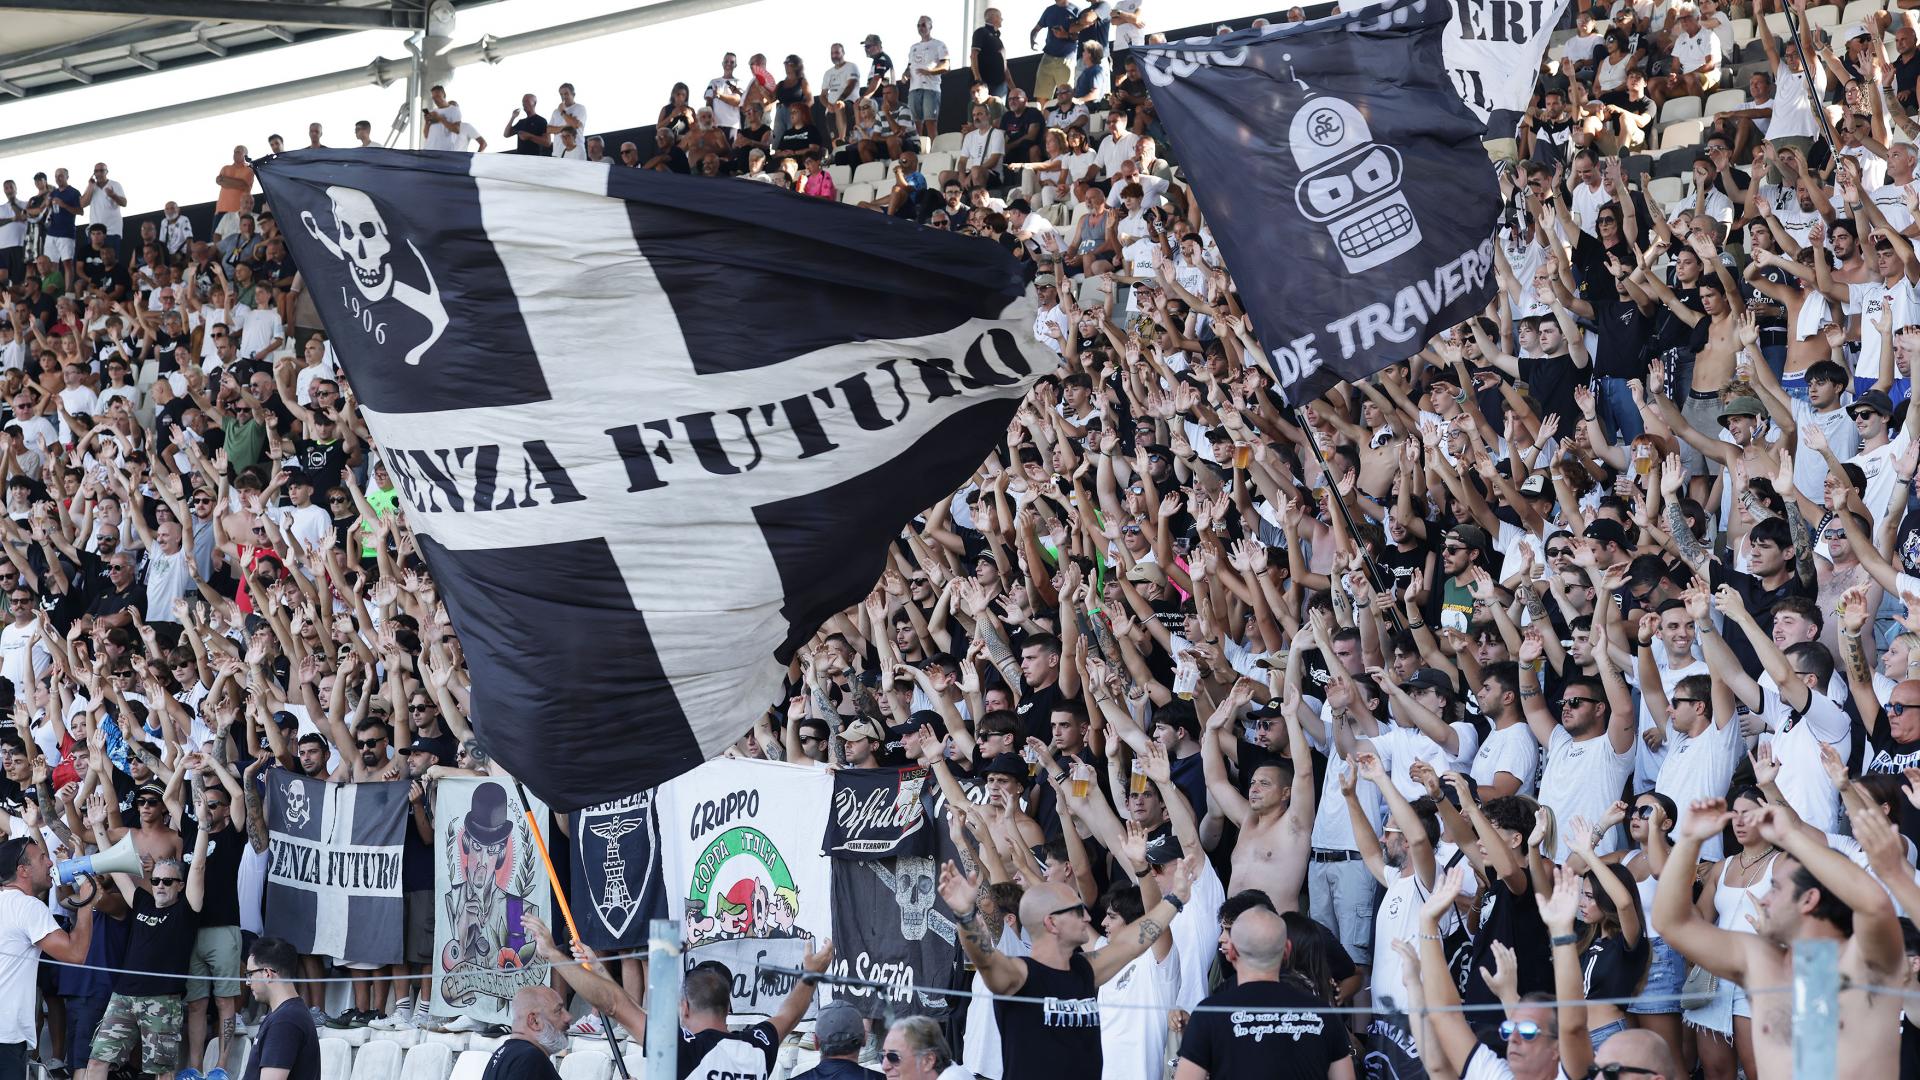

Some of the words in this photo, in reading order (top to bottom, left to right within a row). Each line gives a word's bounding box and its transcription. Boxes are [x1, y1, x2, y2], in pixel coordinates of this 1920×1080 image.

[341, 286, 388, 345] 1906
[1272, 332, 1323, 388] DE
[1325, 238, 1496, 360] TRAVERS
[604, 327, 1032, 493] FUTURO
[690, 789, 759, 841] GRUPPO
[326, 851, 400, 890] FUTURO
[694, 838, 730, 894] COPPA
